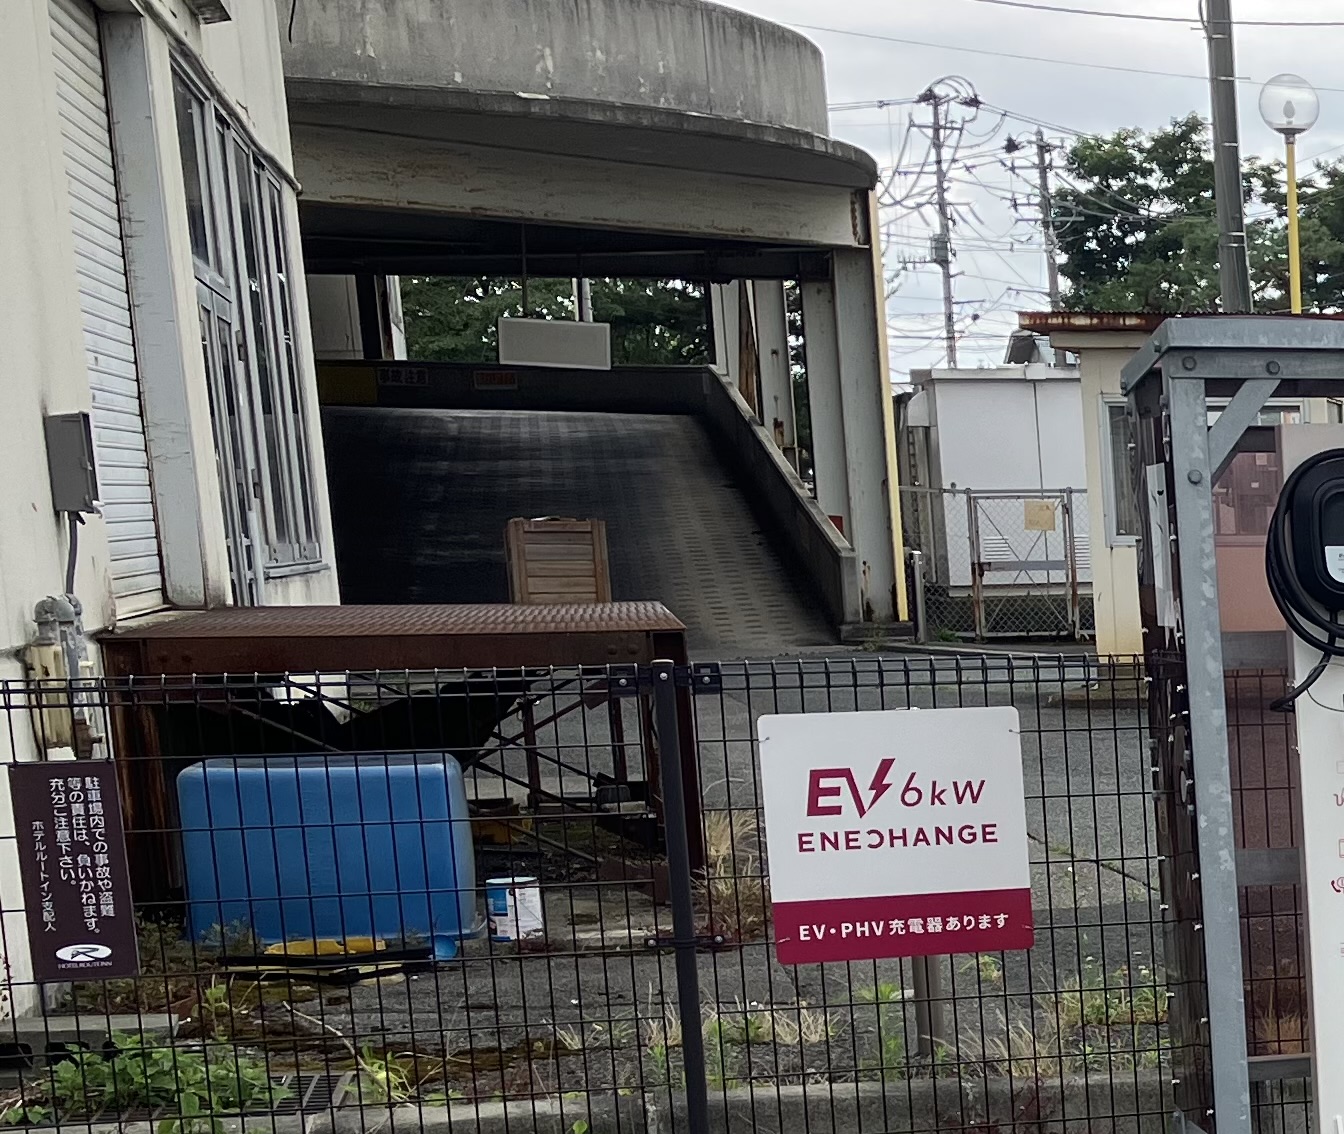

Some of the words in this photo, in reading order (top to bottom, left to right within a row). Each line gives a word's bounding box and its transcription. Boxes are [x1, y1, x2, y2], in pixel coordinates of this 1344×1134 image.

[806, 758, 896, 818] EV
[84, 776, 115, 917] 駐車場内での事故や盗難
[797, 823, 999, 853] ENECHANGE
